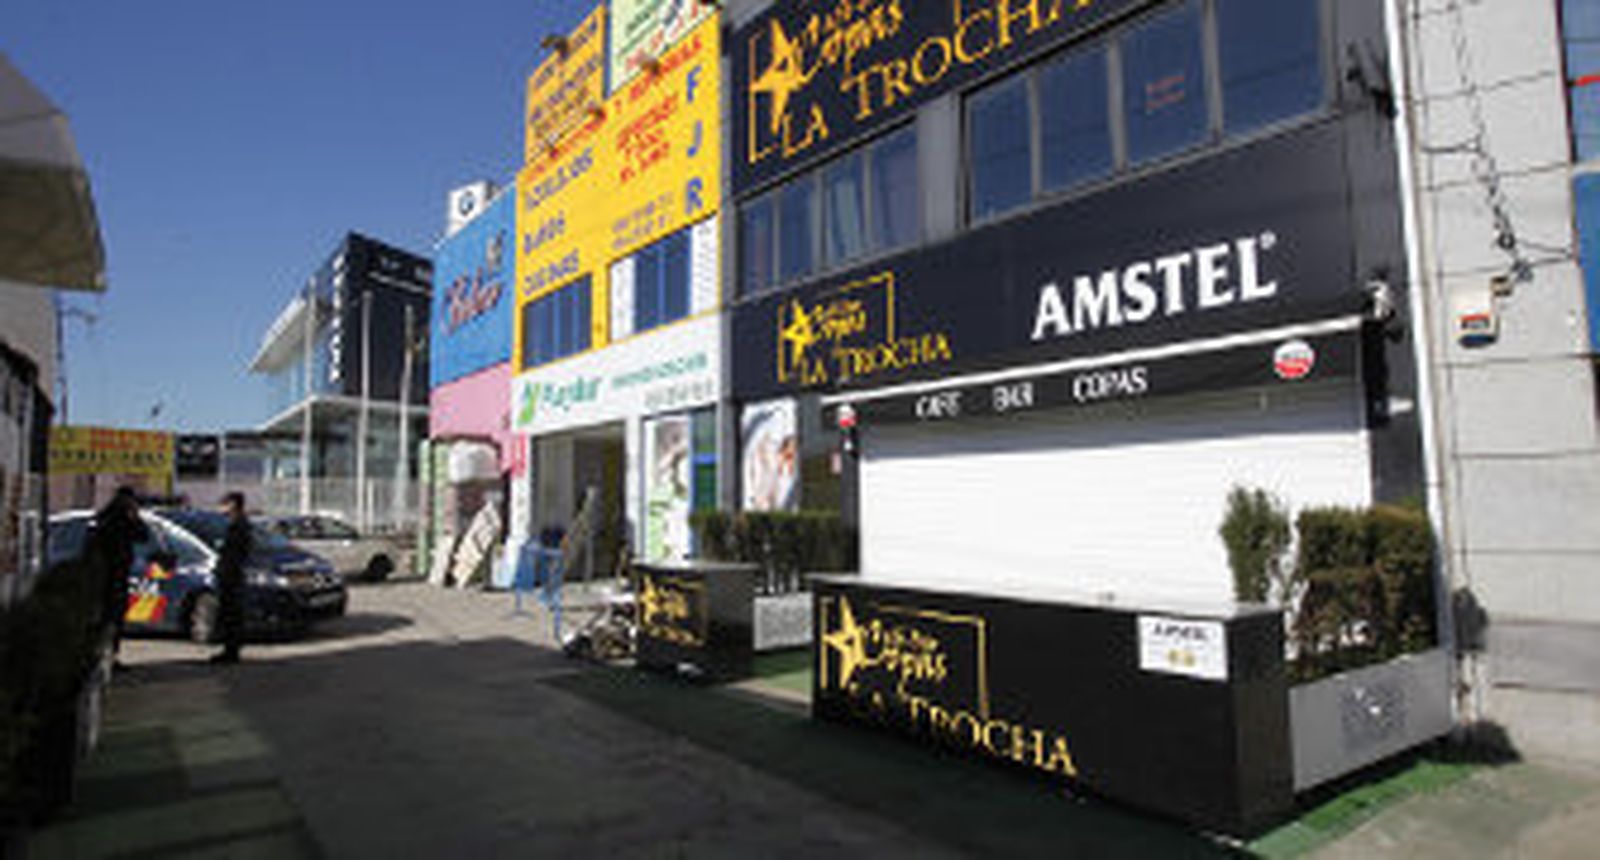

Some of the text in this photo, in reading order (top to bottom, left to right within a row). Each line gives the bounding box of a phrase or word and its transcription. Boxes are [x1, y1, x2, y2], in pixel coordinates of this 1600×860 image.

[779, 104, 829, 158] LA
[1031, 236, 1277, 341] AMSTEL
[800, 332, 952, 384] LA TROCHA
[1072, 366, 1148, 403] COPAS
